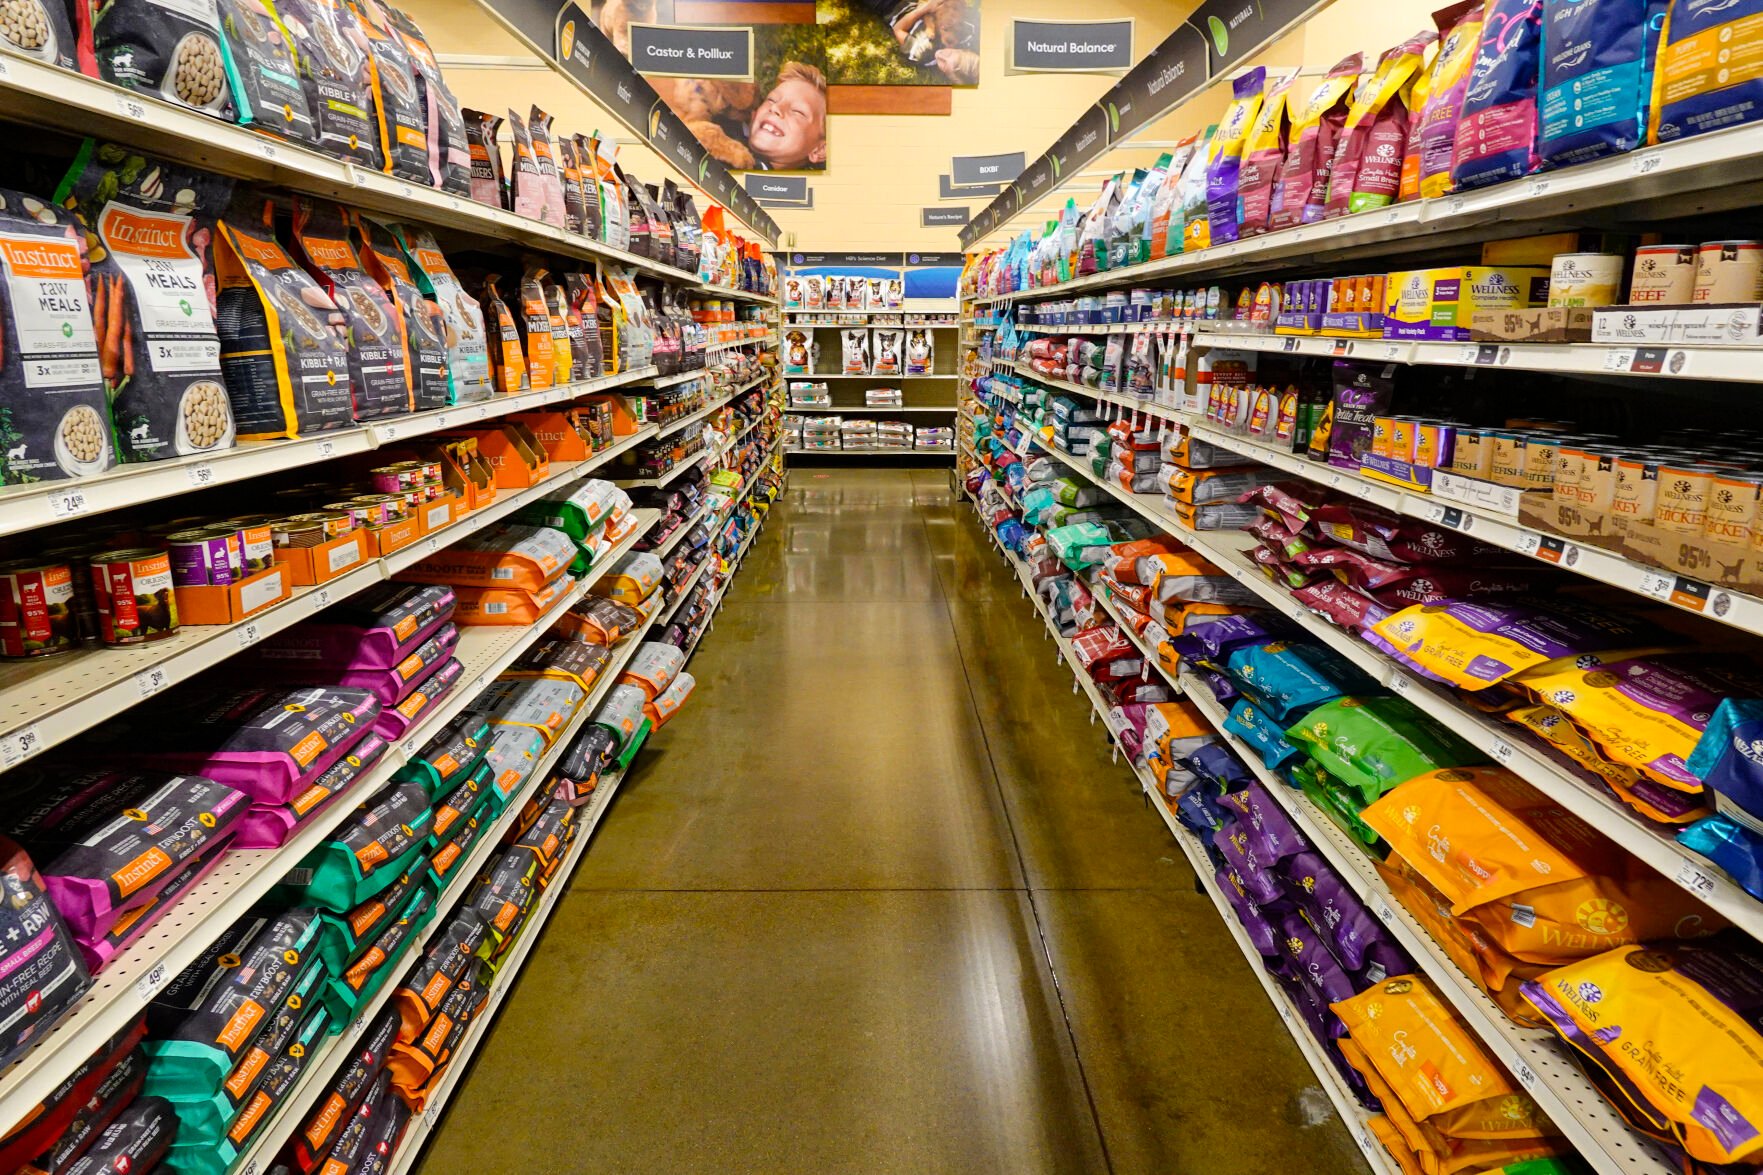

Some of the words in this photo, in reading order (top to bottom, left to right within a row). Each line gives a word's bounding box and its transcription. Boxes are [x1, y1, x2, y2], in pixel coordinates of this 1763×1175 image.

[1229, 5, 1253, 29] NATURALS
[646, 45, 684, 58] Castor
[687, 48, 696, 58] &
[1027, 41, 1067, 53] Natural
[1069, 42, 1117, 53] Balance
[1147, 72, 1165, 97] Natural
[1165, 61, 1185, 86] Balance
[318, 84, 351, 102] KIBBLE
[1364, 155, 1401, 167] WELLNESS
[1358, 174, 1380, 183] Small
[109, 215, 177, 248] Instinct
[6, 243, 78, 269] Instinct
[143, 258, 173, 273] raw
[146, 273, 197, 290] MEALS
[1465, 270, 1472, 278] 6
[1553, 269, 1593, 279] WELLNESS
[39, 281, 69, 297] raw
[1401, 288, 1429, 301] WELLNESS
[1471, 284, 1521, 296] WELLNESS
[1631, 289, 1667, 302] BEEF
[38, 297, 82, 313] MEALS
[1504, 313, 1524, 333] 95%
[1615, 327, 1647, 338] WELLNESS
[159, 346, 173, 358] 3x
[360, 351, 388, 361] KIBBLE
[420, 354, 442, 363] KIBBLE
[37, 364, 52, 376] 3x
[301, 358, 328, 369] KIBBLE
[1335, 408, 1354, 421] Petite
[1354, 410, 1378, 424] Treats
[1531, 457, 1557, 465] WELLNE
[1664, 489, 1703, 503] WELLNESS
[1558, 505, 1582, 527] 95%
[1406, 542, 1457, 558] WELLNESS
[1678, 543, 1712, 570] 95%
[216, 572, 230, 580] 95%
[1396, 588, 1448, 604] WELLNESS
[26, 609, 45, 617] 95%
[1423, 645, 1444, 660] GRAIN
[1444, 655, 1465, 669] FREE
[118, 850, 164, 887] Instinct
[6, 927, 20, 941] +
[23, 902, 50, 937] RAW
[0, 963, 38, 998] IN-FREE
[37, 941, 63, 969] RECIPE
[1, 956, 23, 974] SMALL
[0, 983, 21, 1009] WITH
[20, 977, 39, 995] REAL
[38, 961, 55, 980] BEEF
[1556, 977, 1601, 1023] WELLNESS
[221, 1004, 258, 1044] Instinct
[1621, 1040, 1653, 1075] GRAIN
[1654, 1070, 1688, 1104] FREE
